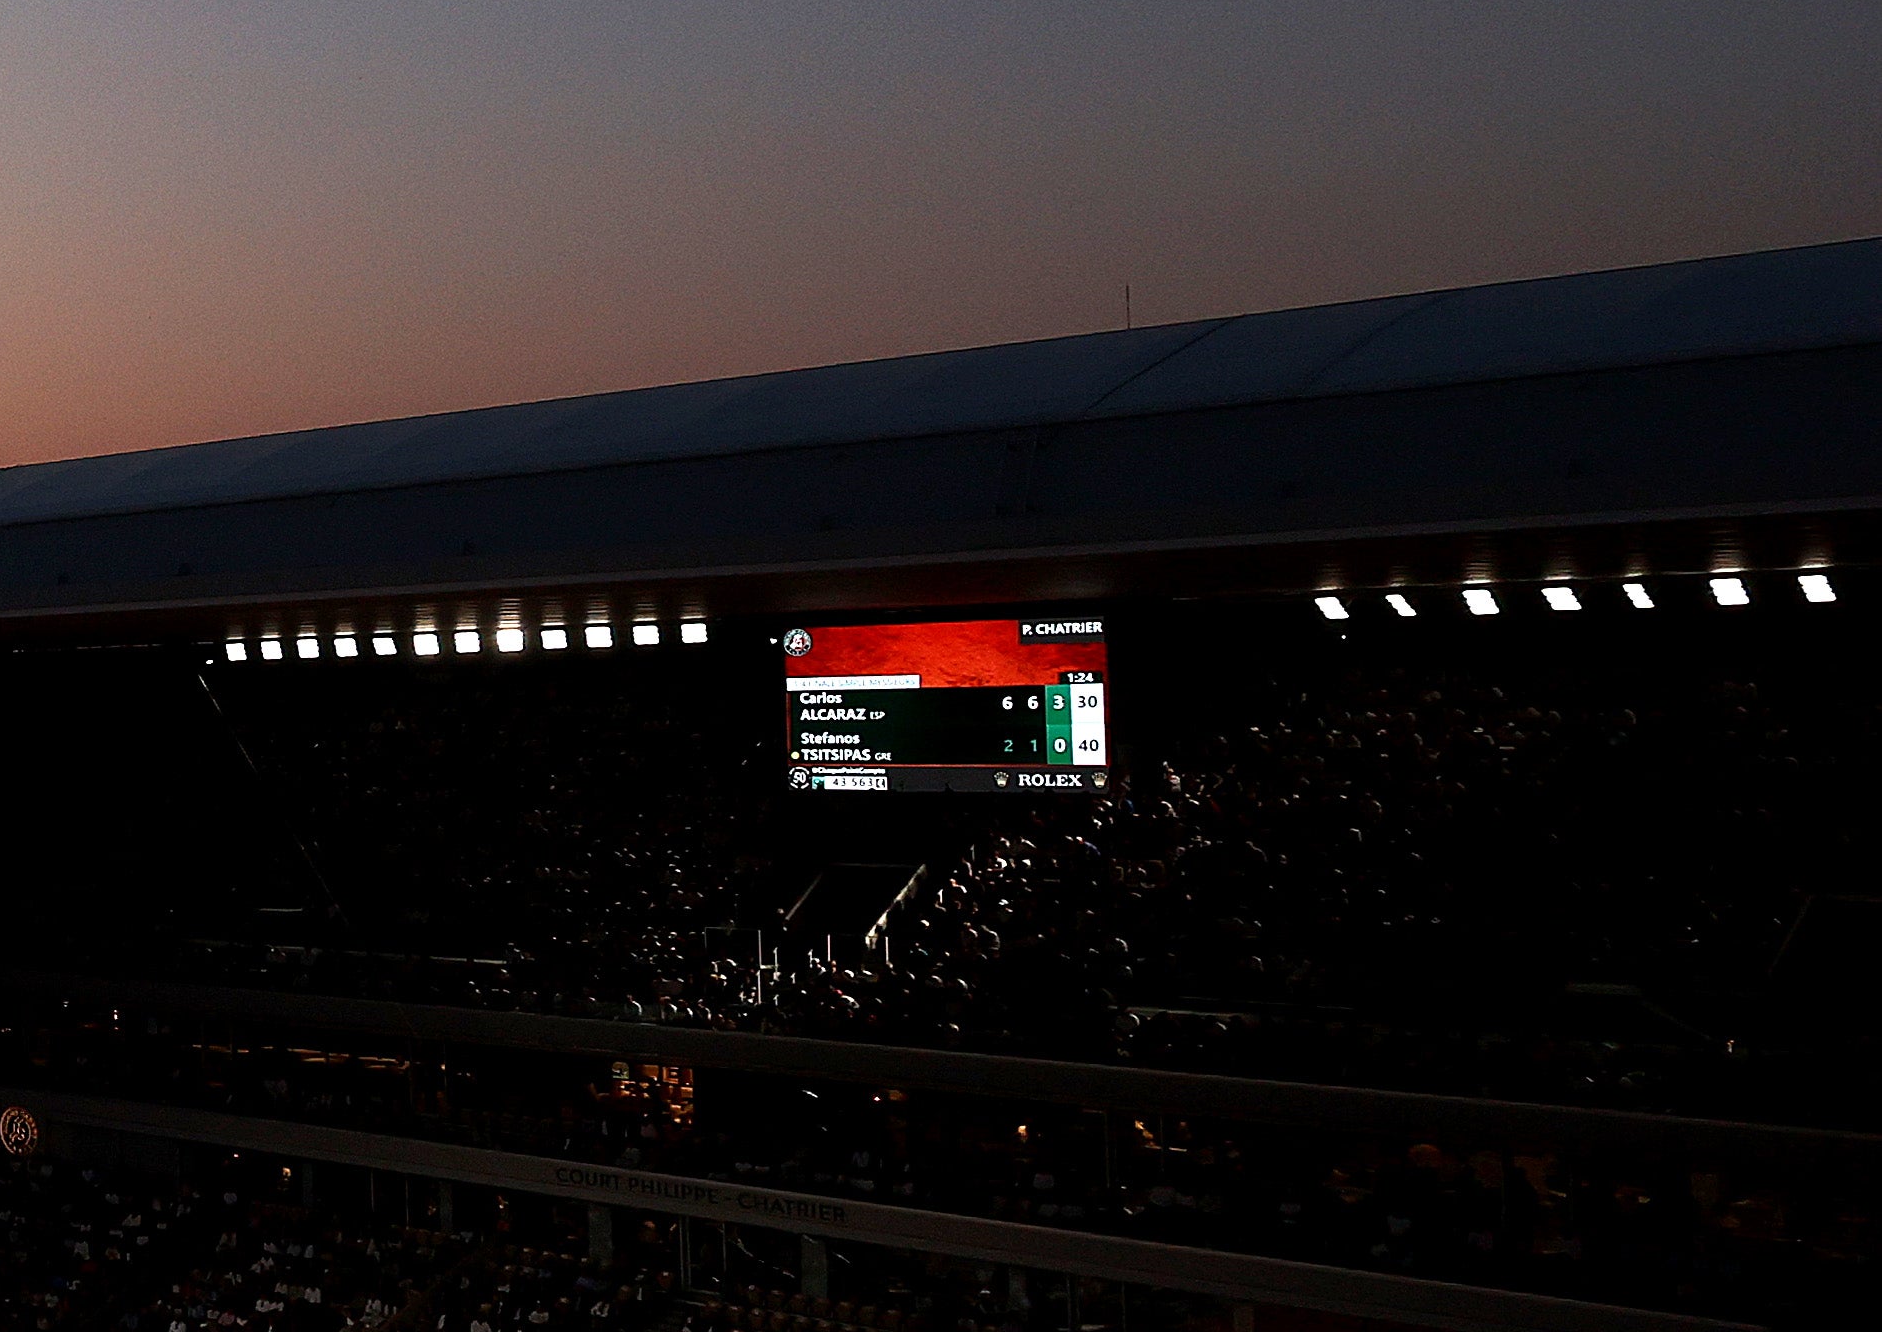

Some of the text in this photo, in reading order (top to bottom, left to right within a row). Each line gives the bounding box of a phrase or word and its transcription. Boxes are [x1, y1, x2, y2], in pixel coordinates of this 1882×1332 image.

[1022, 621, 1103, 635] P. CHATRIER
[1067, 673, 1094, 683] 1:24
[799, 692, 843, 704] Carlos
[1002, 695, 1098, 710] 6 6 3 30
[799, 708, 867, 721] ALCARAZ
[800, 732, 861, 745] Stefanos
[1004, 738, 1099, 753] 2 1 0 40
[801, 749, 893, 761] TSITSIPAS GRE
[1018, 774, 1083, 787] ROLEX
[555, 1167, 621, 1191] COURT
[627, 1178, 719, 1205] PHILIPPE
[737, 1191, 847, 1224] CHATRIER
